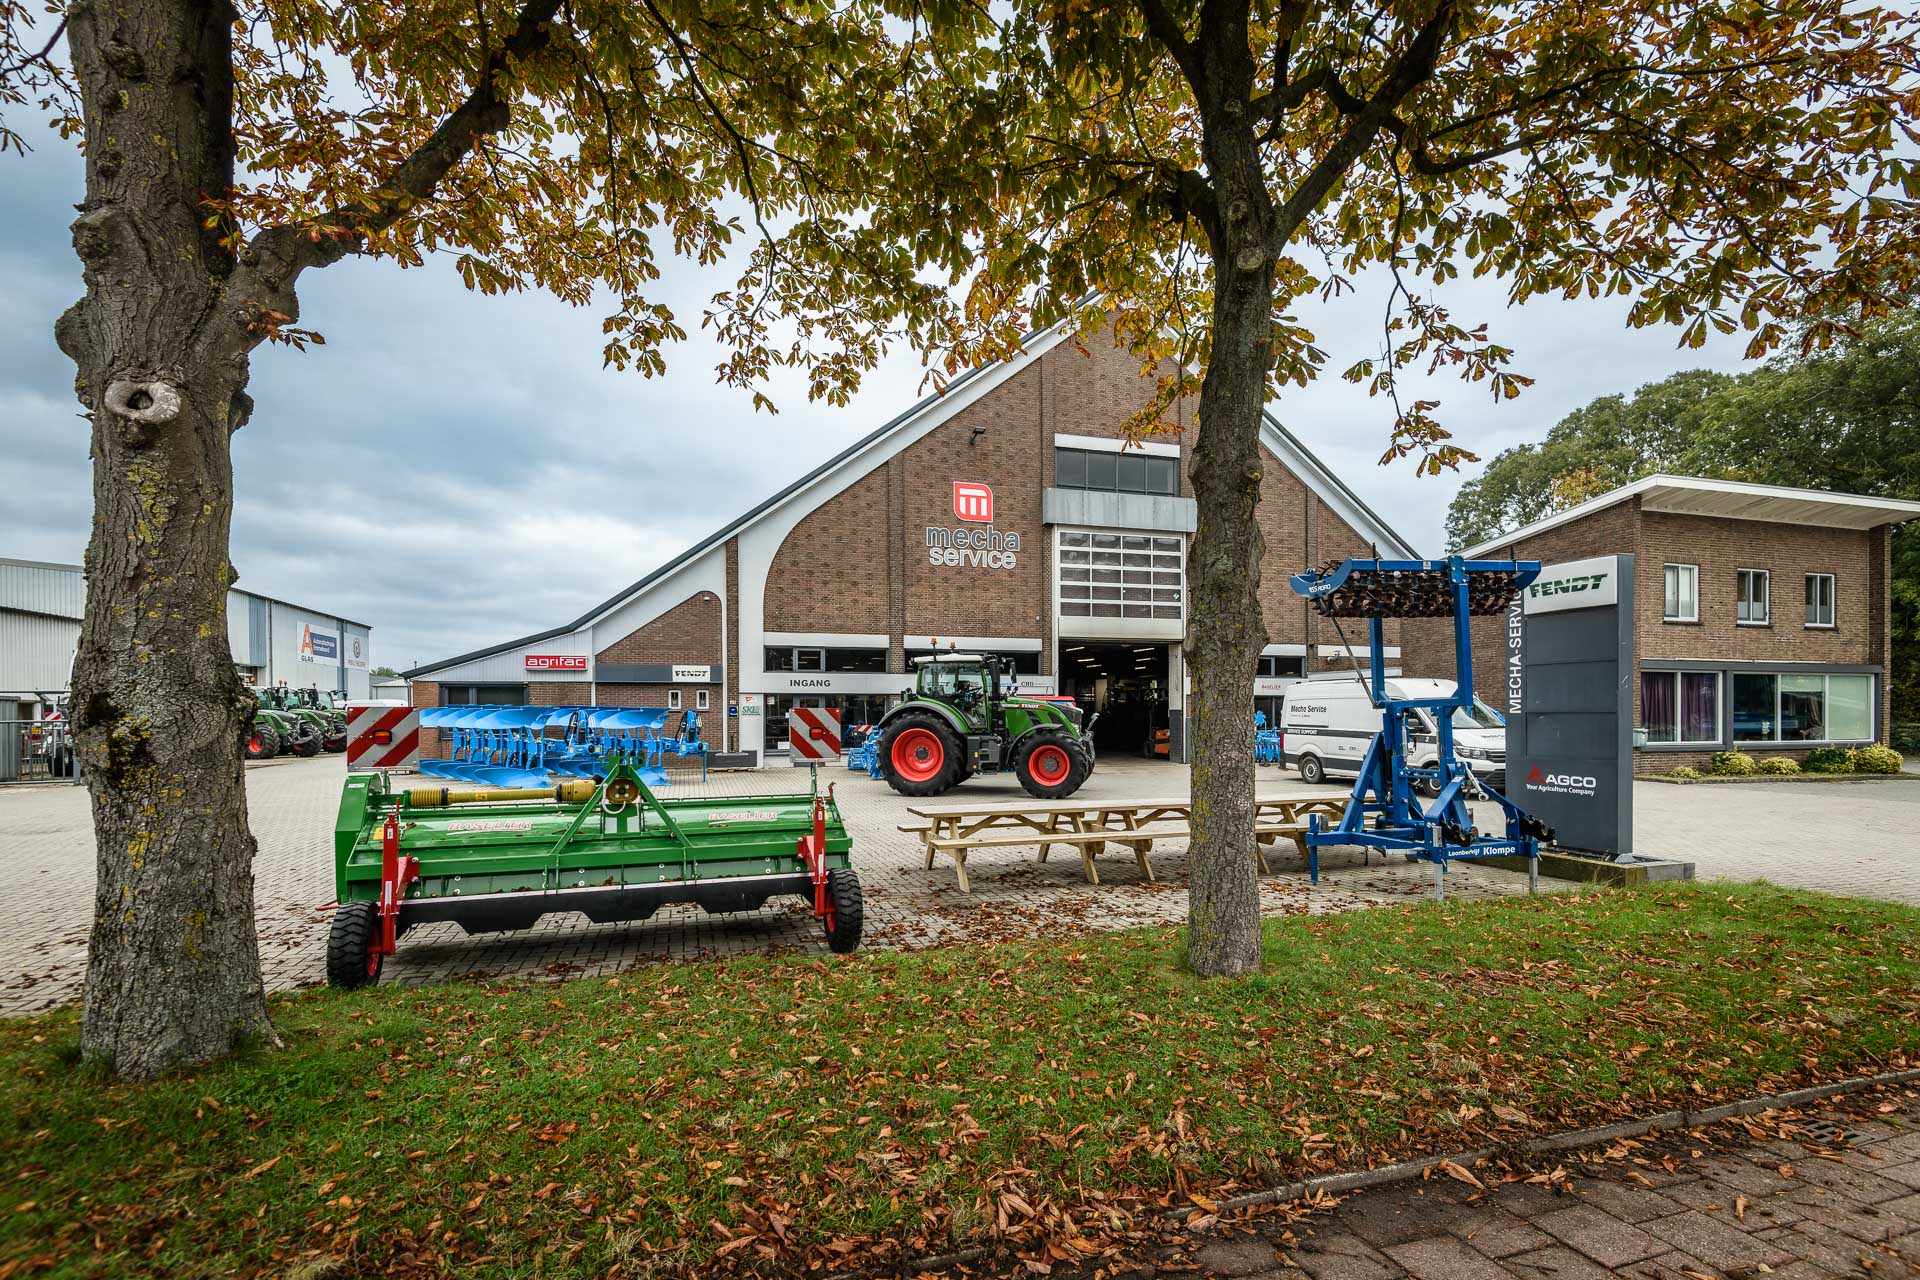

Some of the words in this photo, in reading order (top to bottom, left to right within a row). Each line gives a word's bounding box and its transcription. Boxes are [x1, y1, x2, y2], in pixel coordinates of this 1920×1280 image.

[926, 525, 1021, 552] mecha
[929, 547, 1017, 570] service
[1529, 573, 1608, 598] FENDT
[1509, 590, 1522, 714] MECHA-SERVIC
[527, 657, 585, 668] agrifac
[789, 679, 831, 687] INGANG
[1290, 705, 1306, 713] Mecha
[1307, 705, 1327, 713] Service
[1545, 774, 1597, 788] AGCO
[1538, 784, 1568, 793] Agriculture
[1568, 787, 1595, 797] Company
[710, 811, 778, 821] BASELIER
[447, 820, 532, 831] BASELIER
[1483, 846, 1516, 856] Klompe
